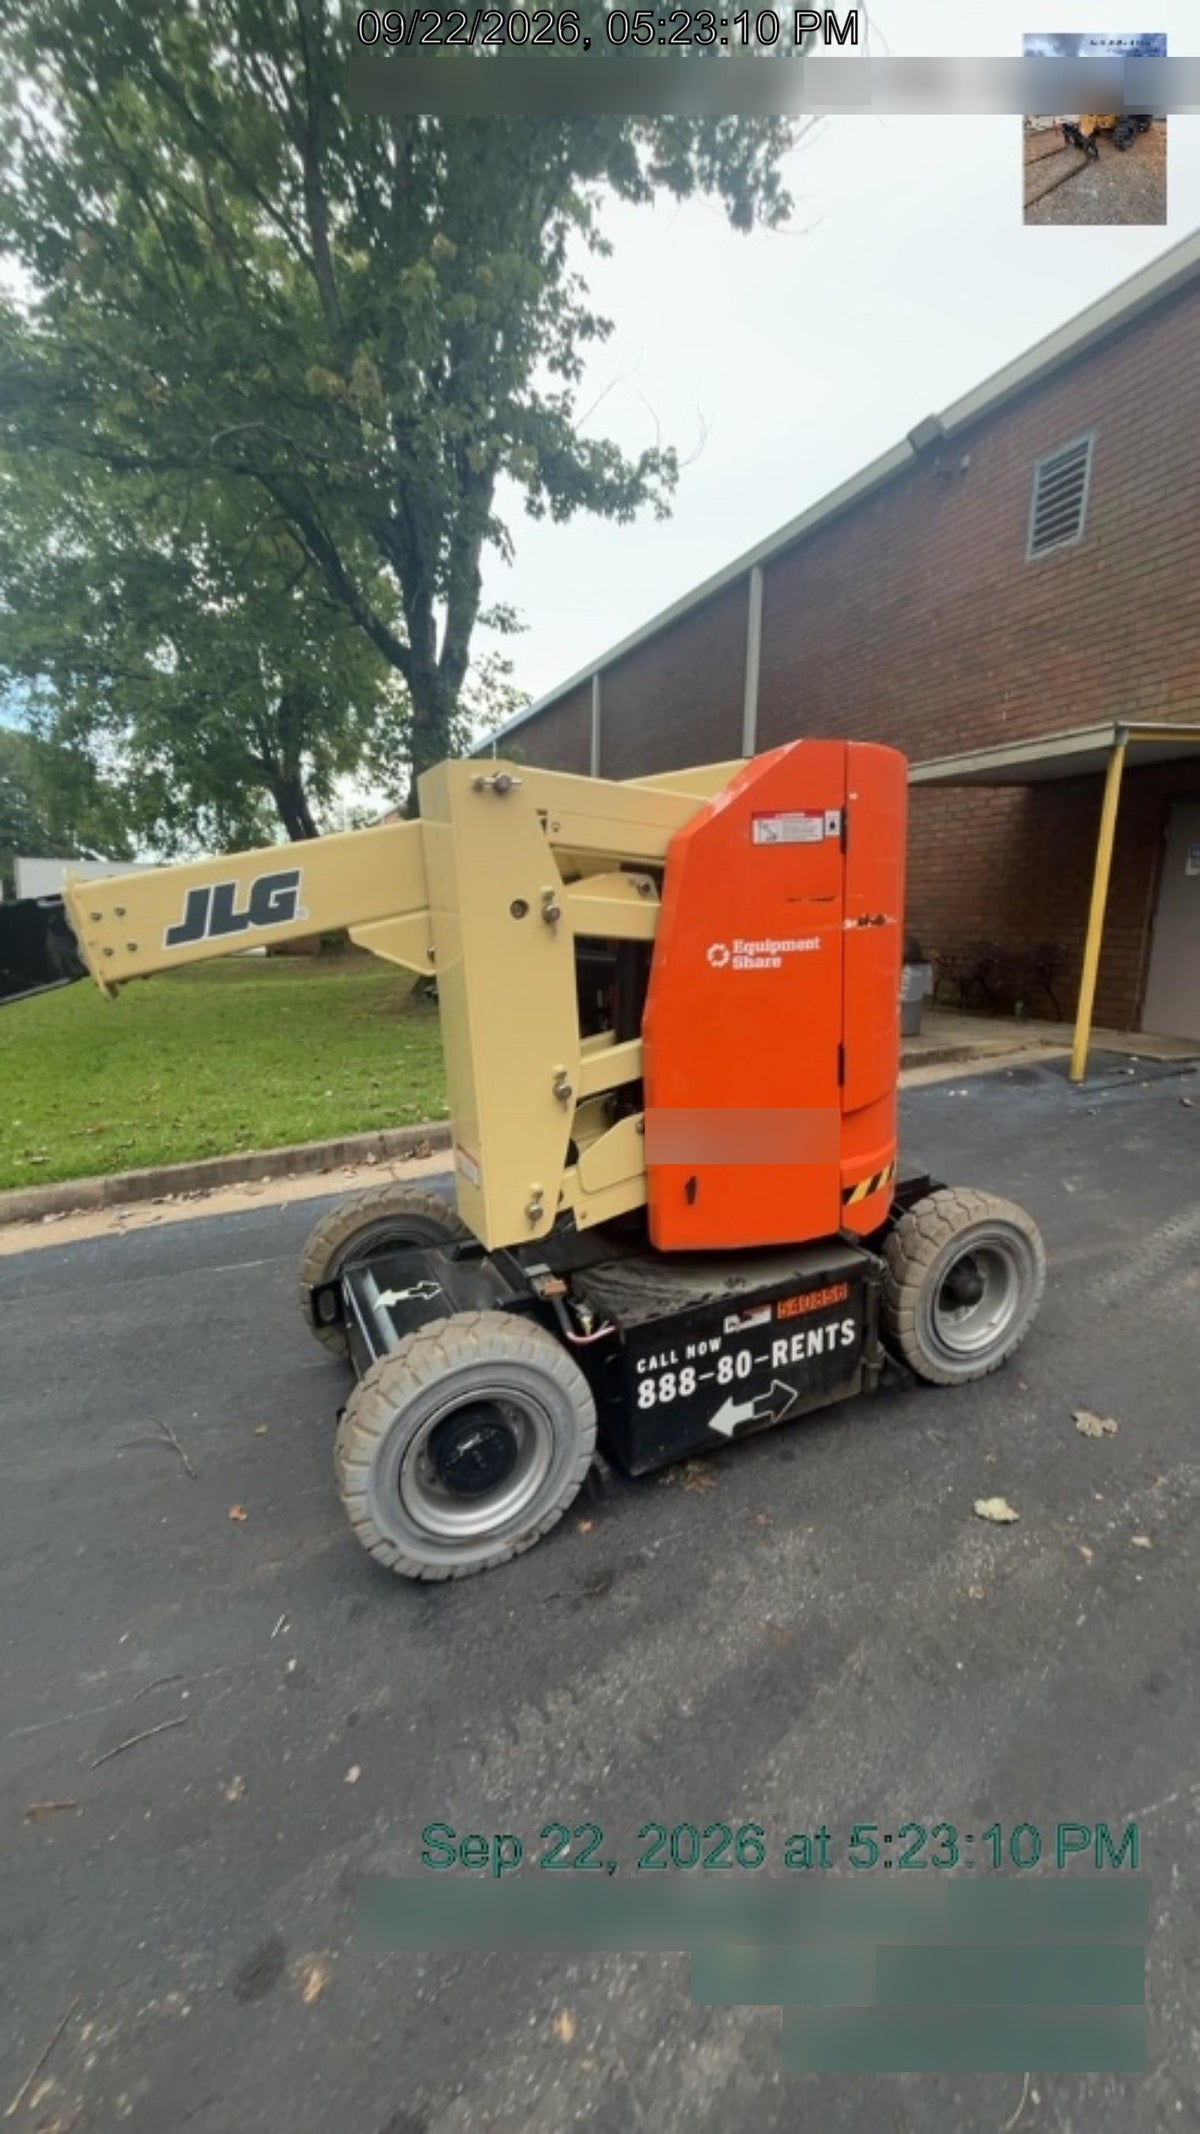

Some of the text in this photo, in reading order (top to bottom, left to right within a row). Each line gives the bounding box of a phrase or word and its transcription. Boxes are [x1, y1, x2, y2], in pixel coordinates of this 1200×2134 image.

[164, 868, 301, 948] JLG
[731, 936, 821, 956] Equipment
[731, 955, 782, 970] Share
[636, 1336, 722, 1374] CALL NOW
[637, 1318, 856, 1409] 888-80-RENTS
